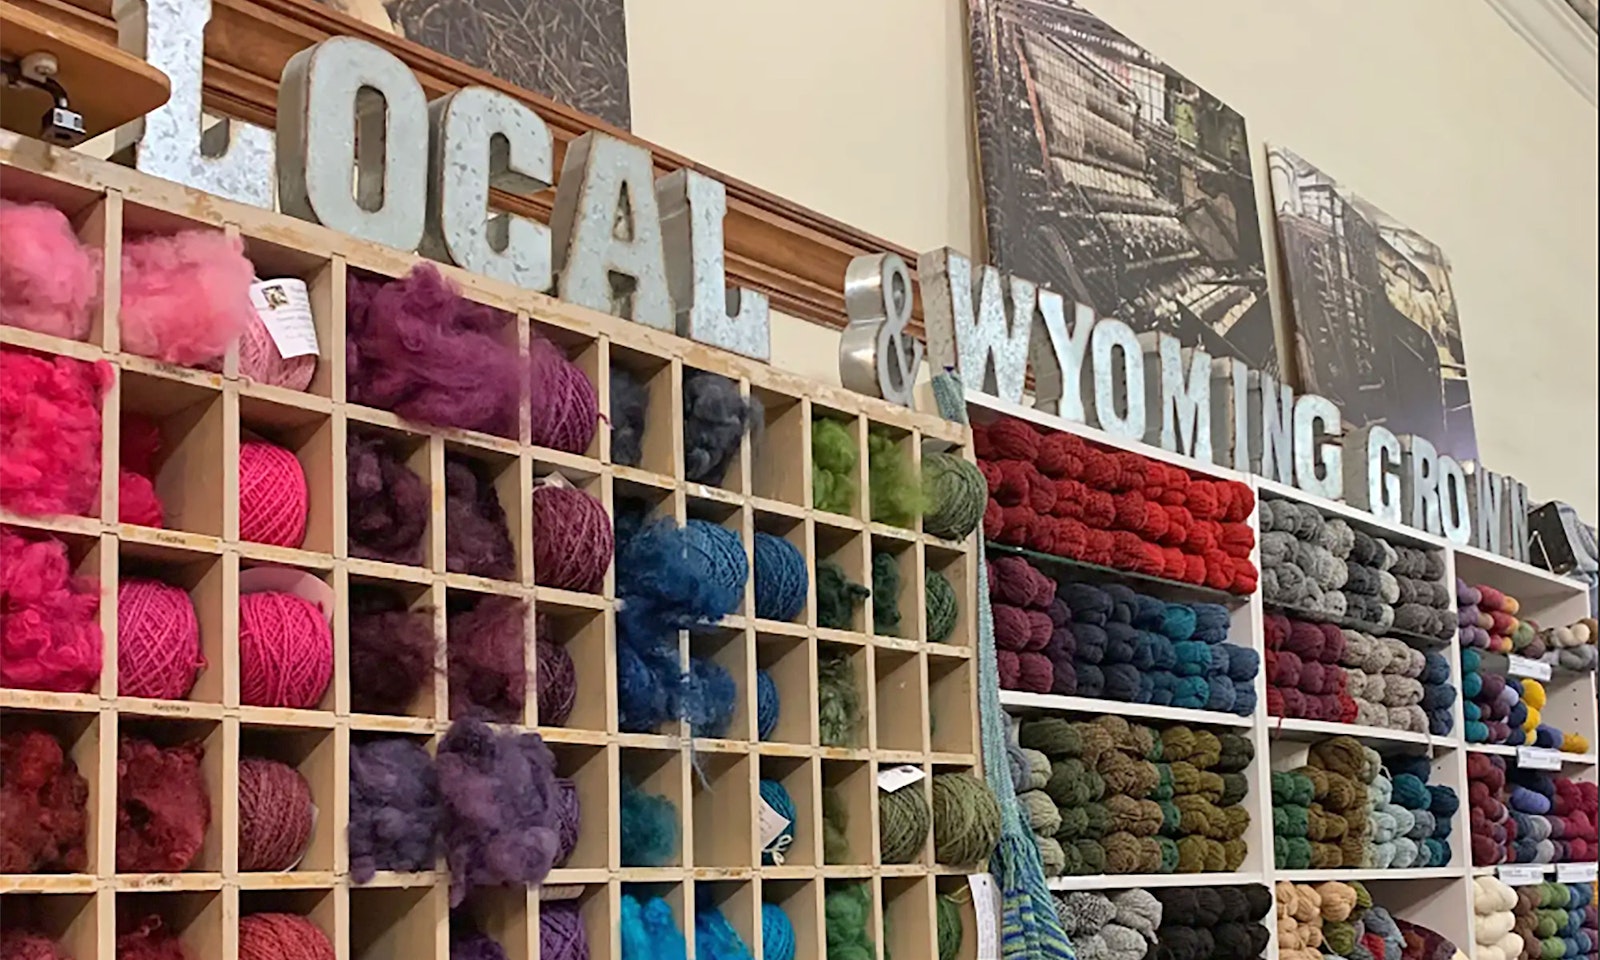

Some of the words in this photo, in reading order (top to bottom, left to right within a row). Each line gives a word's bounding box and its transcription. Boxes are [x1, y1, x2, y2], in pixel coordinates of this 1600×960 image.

[136, 0, 770, 362] LOCAL
[878, 252, 925, 407] &
[947, 248, 1343, 500] WYOMING
[1368, 425, 1529, 564] GROWN
